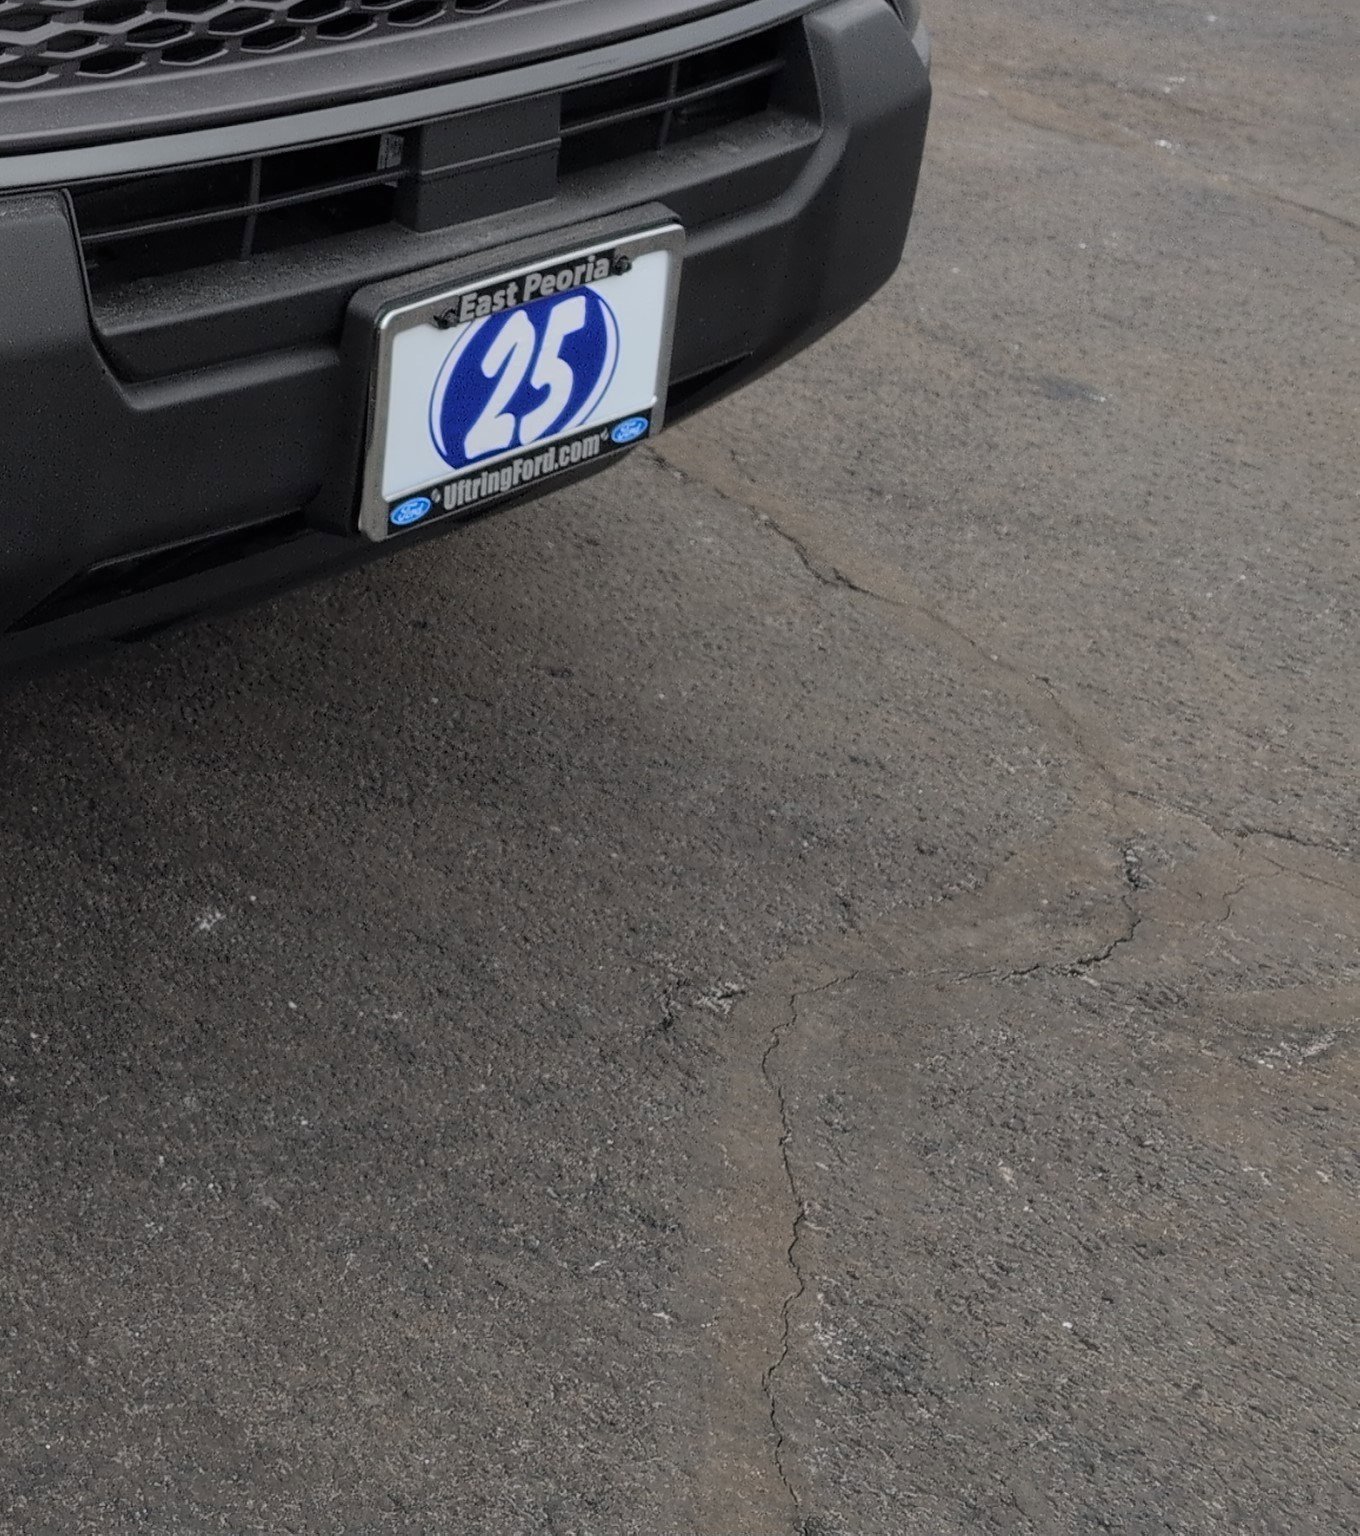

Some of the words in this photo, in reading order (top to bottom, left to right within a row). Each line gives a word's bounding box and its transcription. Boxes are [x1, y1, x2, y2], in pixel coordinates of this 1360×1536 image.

[458, 281, 519, 323] East
[523, 255, 610, 302] Peoria
[464, 295, 586, 460] 25
[443, 434, 601, 510] UftringFord.com
